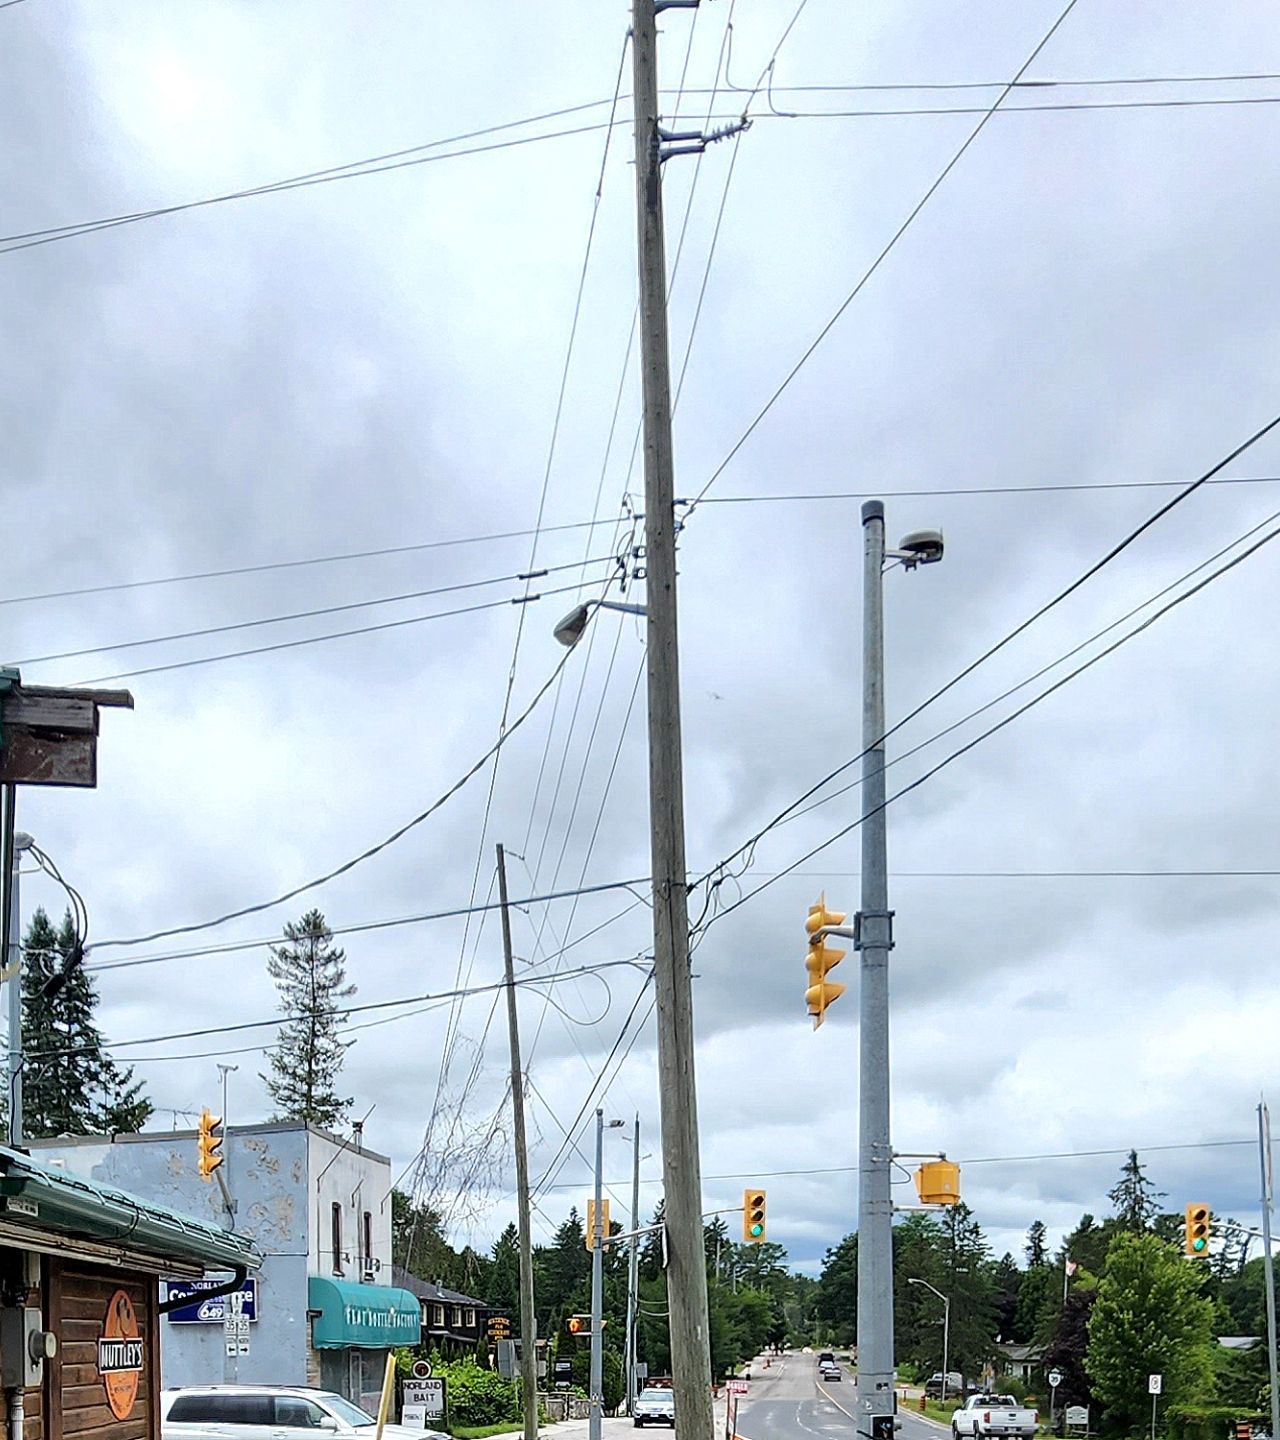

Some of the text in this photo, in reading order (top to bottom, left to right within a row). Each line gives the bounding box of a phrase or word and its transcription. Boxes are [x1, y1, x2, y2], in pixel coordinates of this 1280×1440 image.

[201, 1305, 223, 1318] 649
[101, 1343, 142, 1368] MUTTLEY'S
[403, 1381, 442, 1390] NORLAND
[413, 1393, 436, 1402] BAIT
